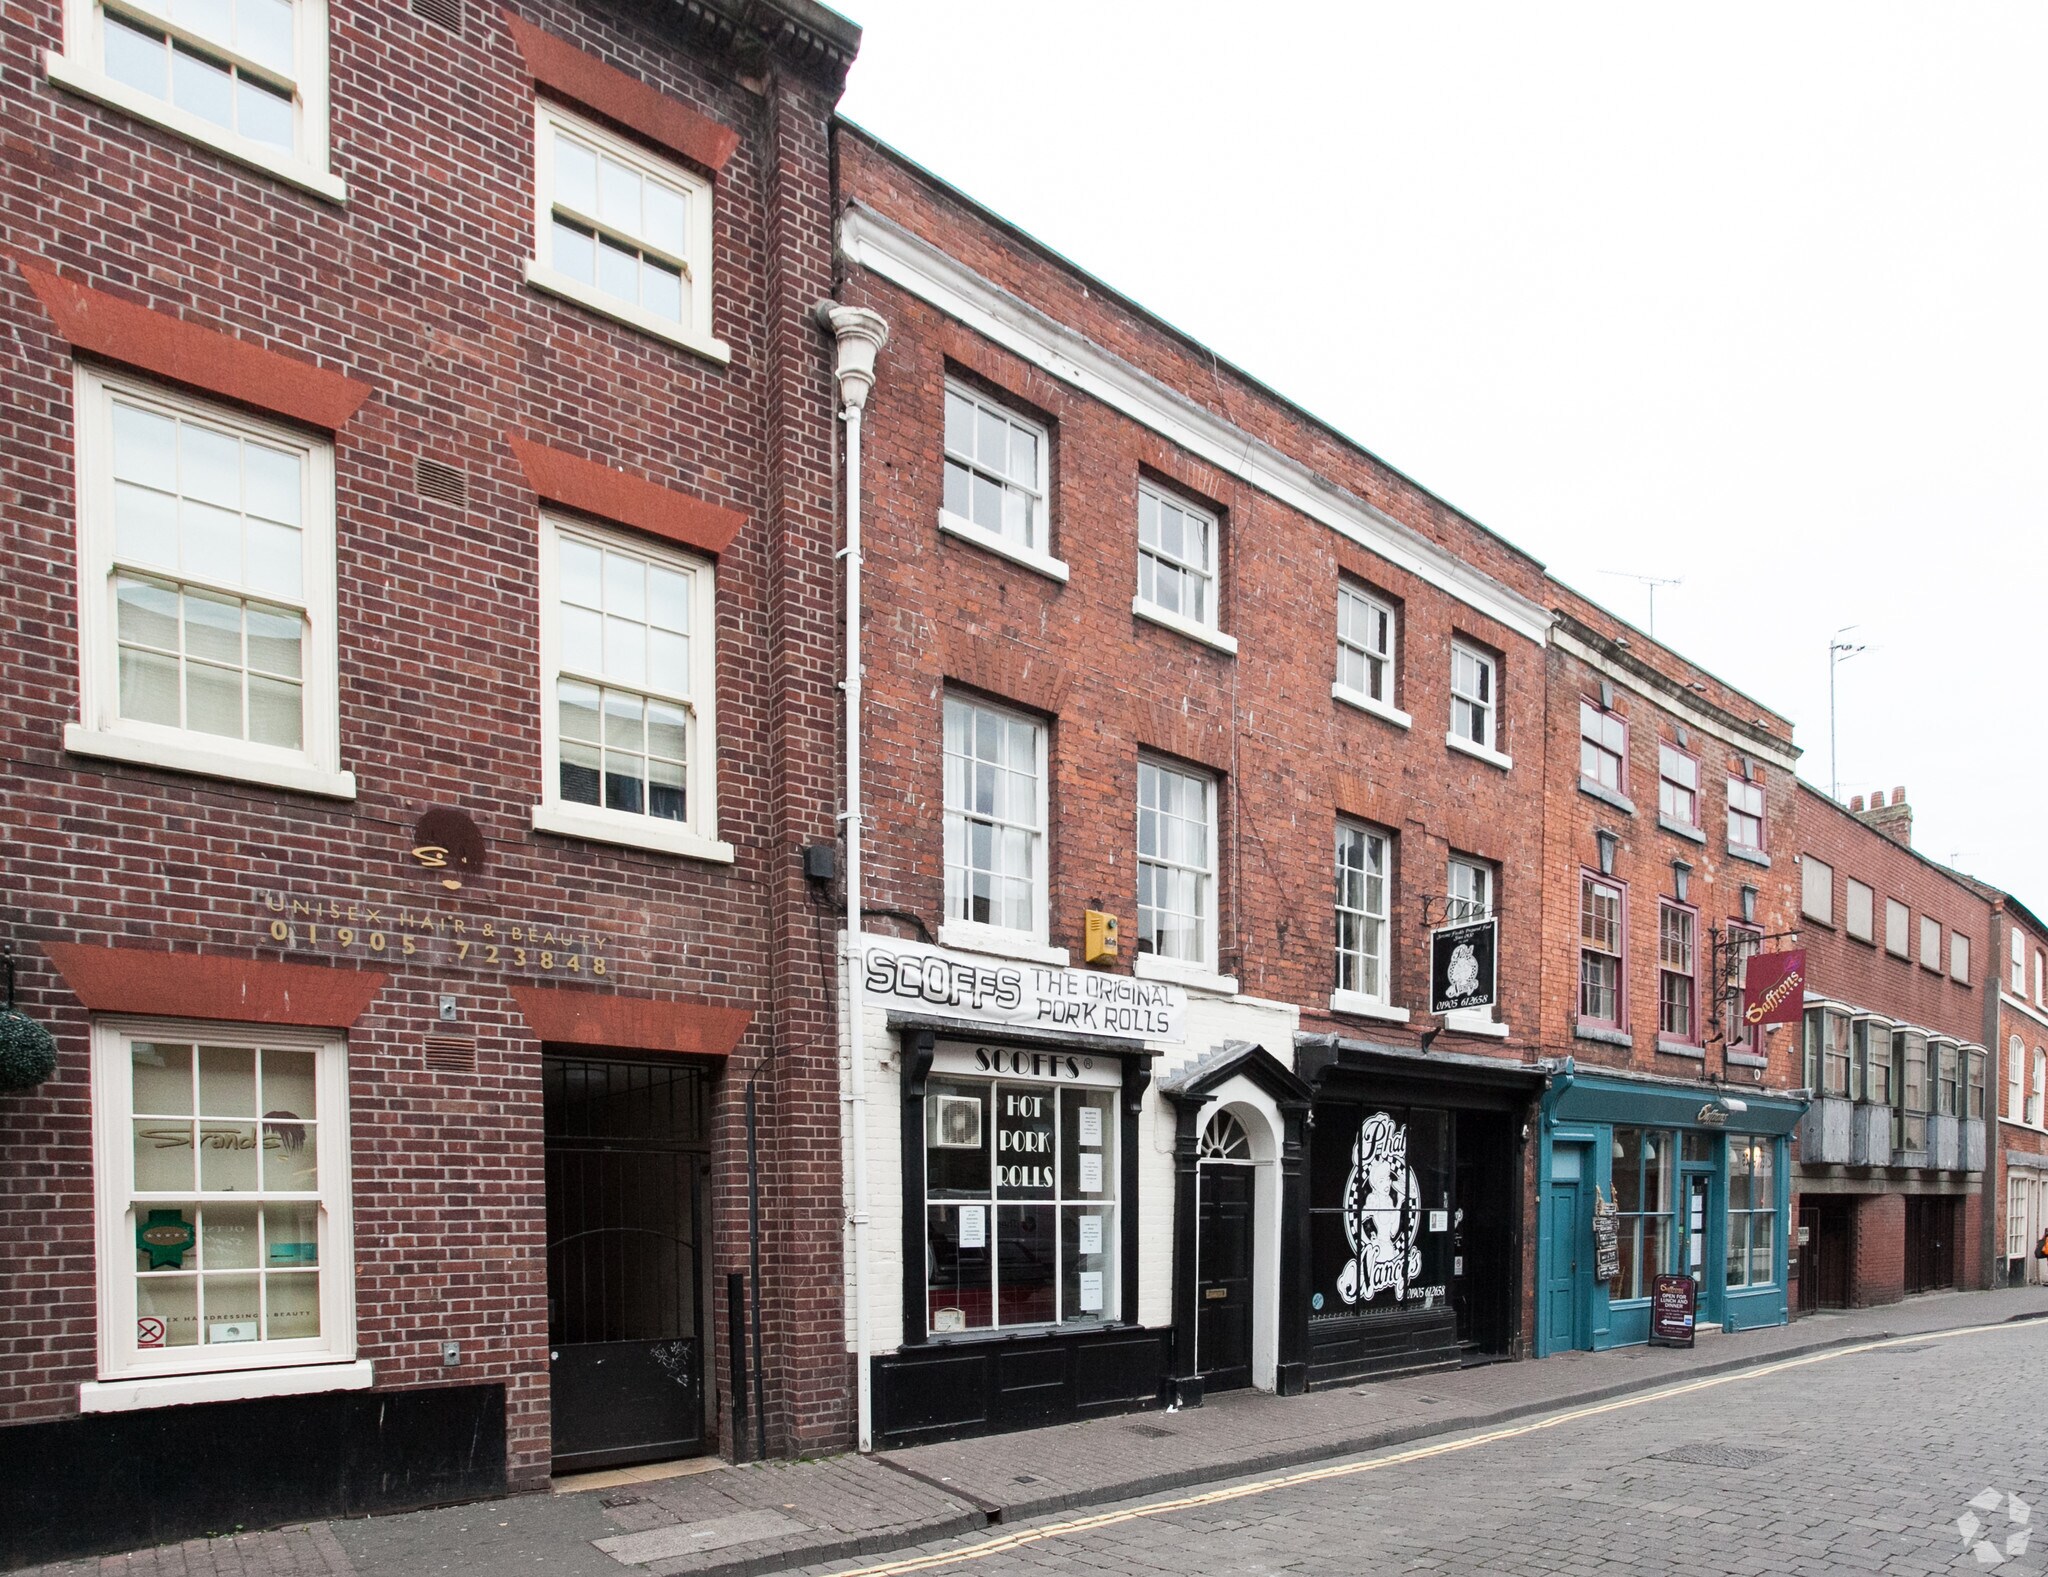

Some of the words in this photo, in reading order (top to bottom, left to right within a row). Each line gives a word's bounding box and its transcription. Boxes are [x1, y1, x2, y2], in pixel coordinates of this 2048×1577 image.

[269, 896, 381, 925] UNISEX
[400, 912, 467, 935] HAIR
[482, 923, 495, 937] &
[511, 926, 607, 951] BEAUTY
[270, 919, 416, 955] 01905
[457, 940, 607, 976] 723848
[865, 947, 1022, 1010] SCOFFS
[1029, 967, 1078, 996] THE
[1085, 974, 1175, 1008] ORIGINAL
[1436, 999, 1458, 1010] 01905
[1461, 994, 1488, 1006] 612658
[1745, 971, 1800, 1023] Saffrons
[1036, 997, 1098, 1030] PORK
[1104, 1006, 1170, 1034] ROLLS
[1007, 1094, 1043, 1118] HOT
[139, 1125, 283, 1151] Strands
[1000, 1130, 1051, 1153] PORK
[996, 1165, 1054, 1188] ROLLS
[1406, 1287, 1424, 1299] 01905
[1425, 1285, 1446, 1297] 612658
[184, 1313, 259, 1322] HARDRESSING
[273, 1310, 311, 1318] BEAUTY
